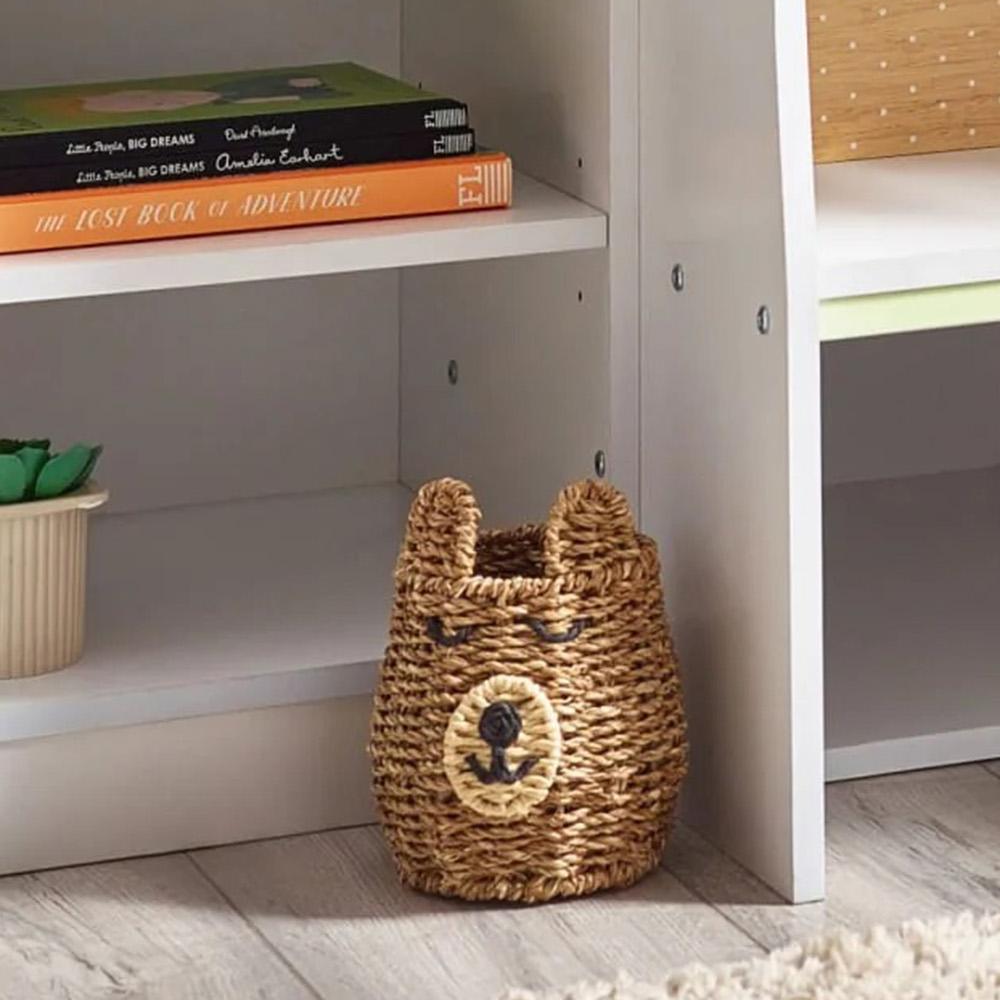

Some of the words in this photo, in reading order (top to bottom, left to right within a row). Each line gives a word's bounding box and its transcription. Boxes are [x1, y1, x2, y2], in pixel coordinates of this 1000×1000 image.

[66, 143, 92, 155] Little
[128, 138, 147, 150] BIG
[150, 133, 196, 148] DREAMS
[76, 171, 102, 183] Little
[138, 166, 158, 178] BIG
[160, 161, 206, 175] DREAMS
[216, 151, 276, 171] Amelia
[279, 143, 344, 165] Earhart
[34, 216, 65, 233] THE
[75, 207, 127, 230] LOST
[136, 201, 199, 225] BOOK
[208, 203, 226, 217] OF
[238, 185, 366, 216] ADVENTURE
